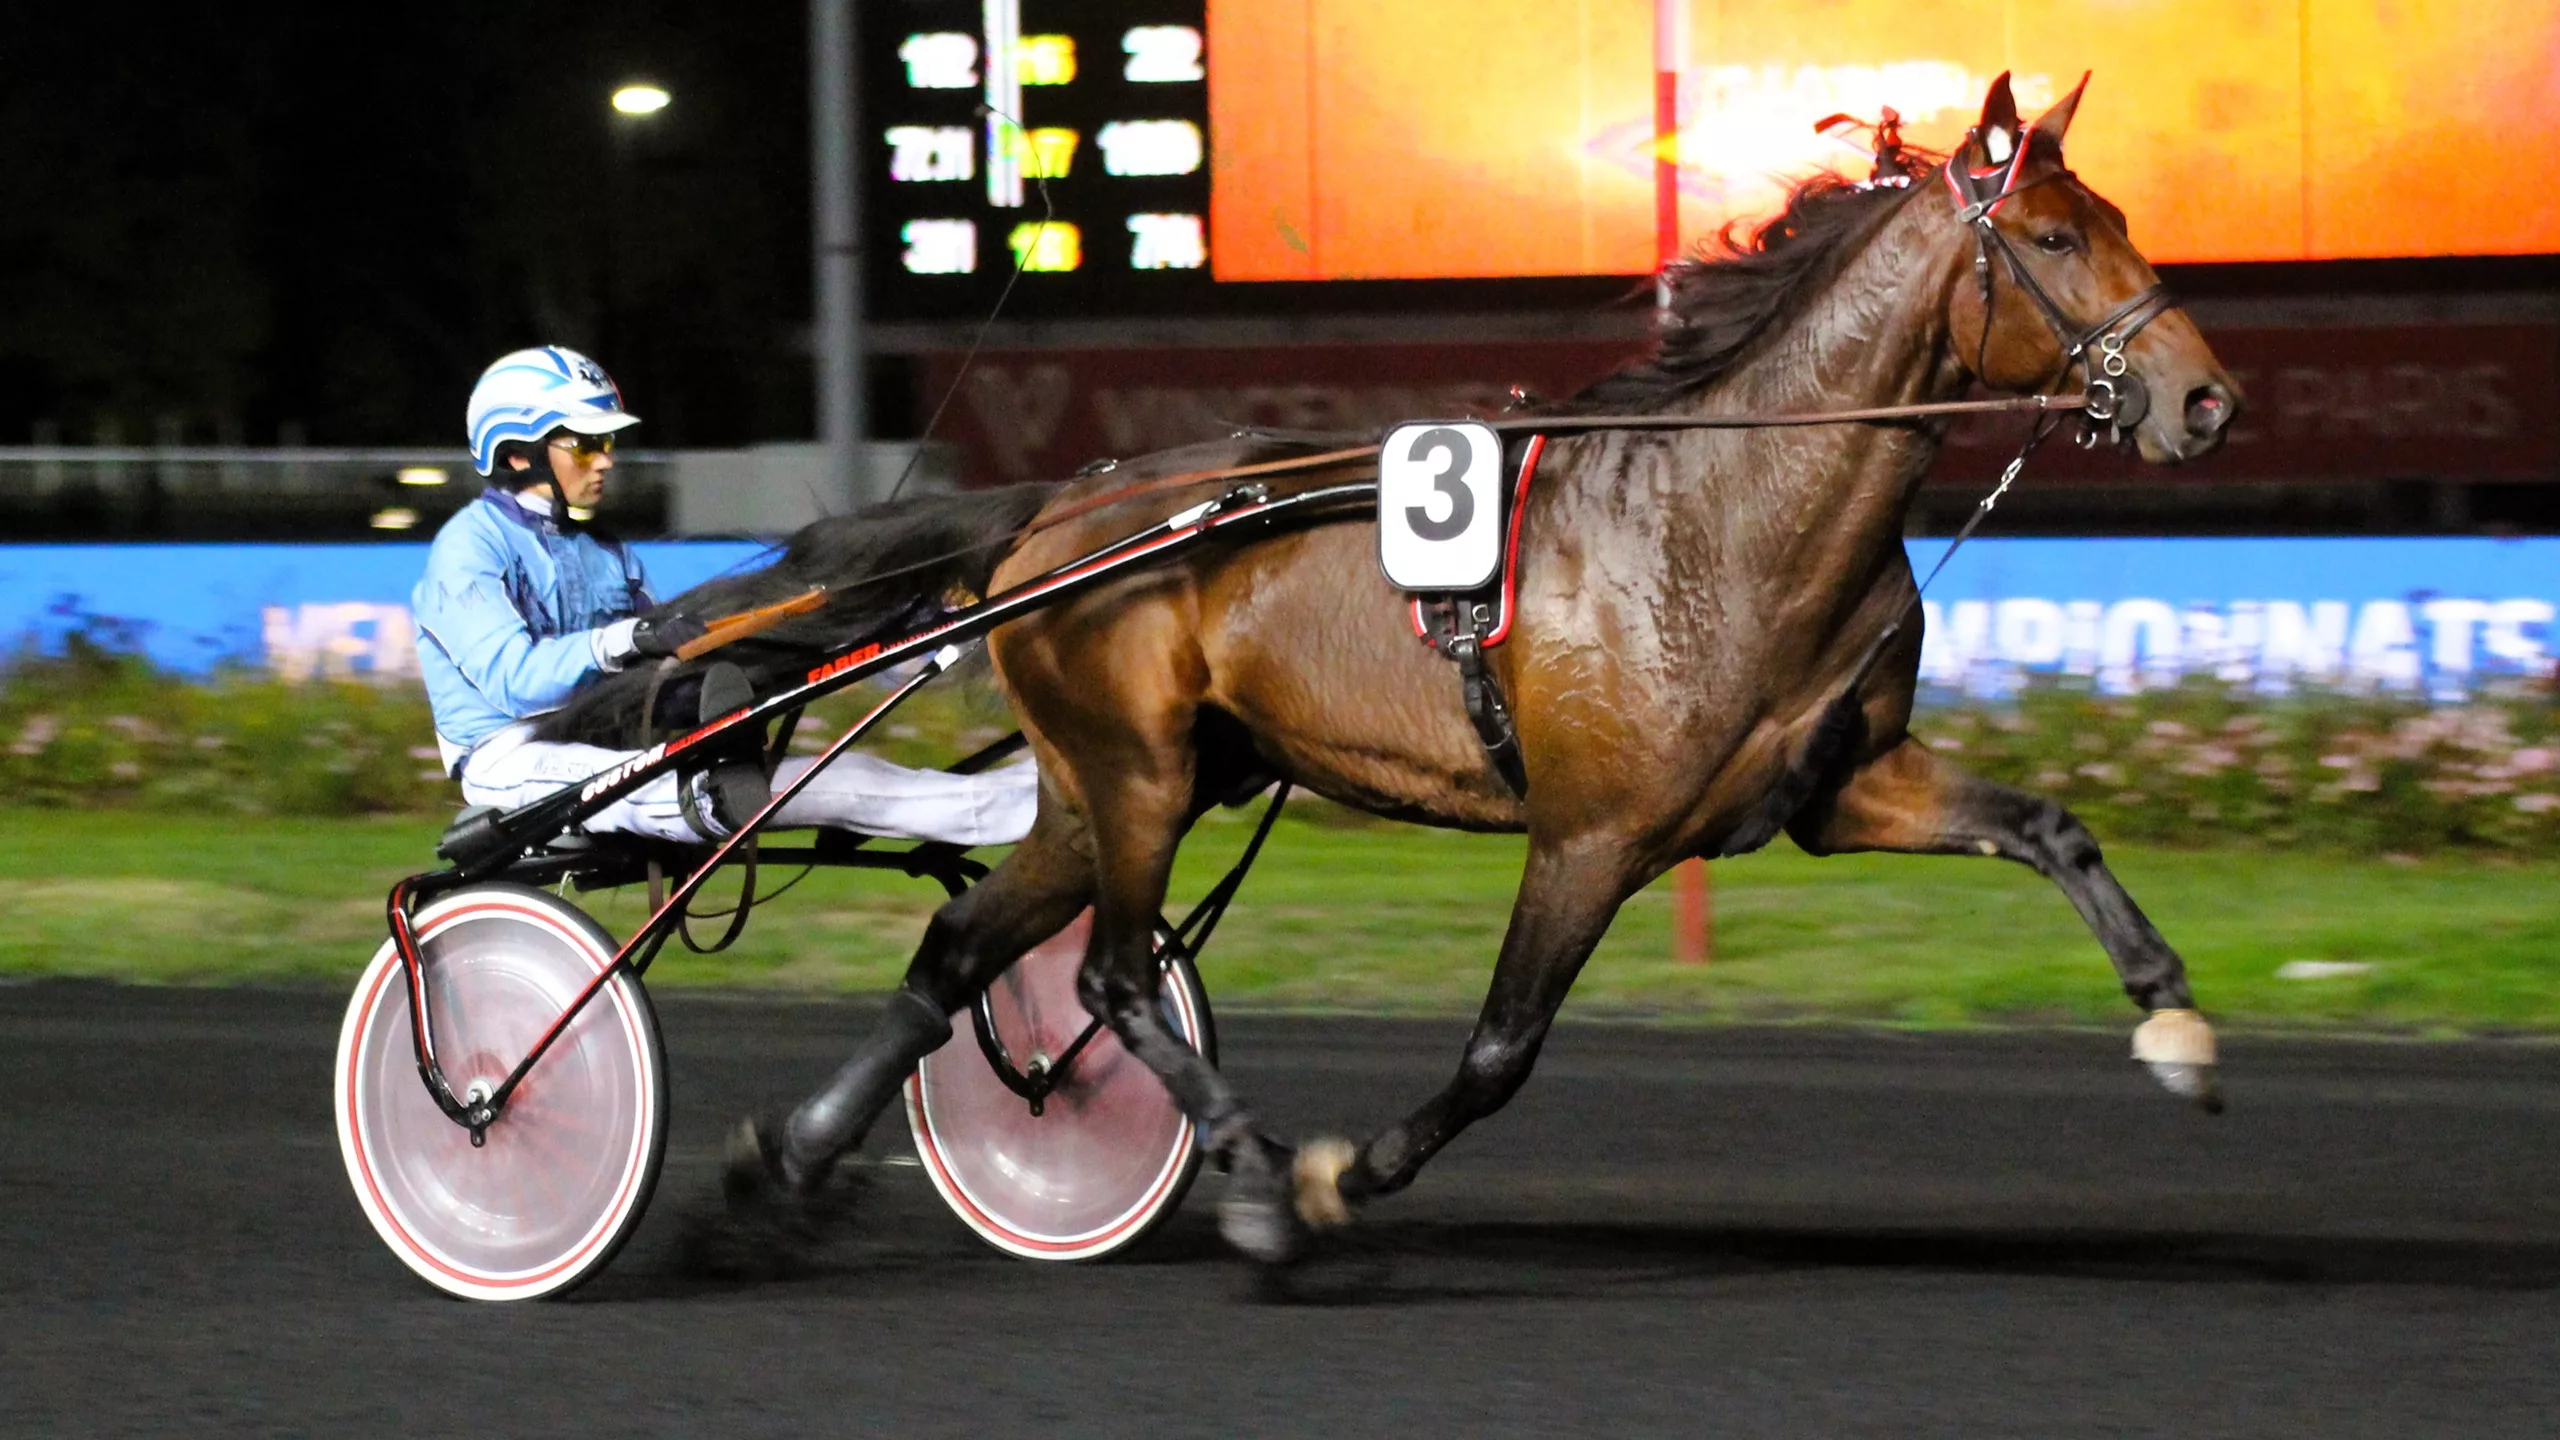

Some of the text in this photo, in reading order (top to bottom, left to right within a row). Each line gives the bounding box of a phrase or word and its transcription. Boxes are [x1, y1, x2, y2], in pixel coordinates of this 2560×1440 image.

[1404, 427, 1475, 542] 3
[806, 642, 881, 684] FABER
[581, 742, 667, 803] CUSTOM
